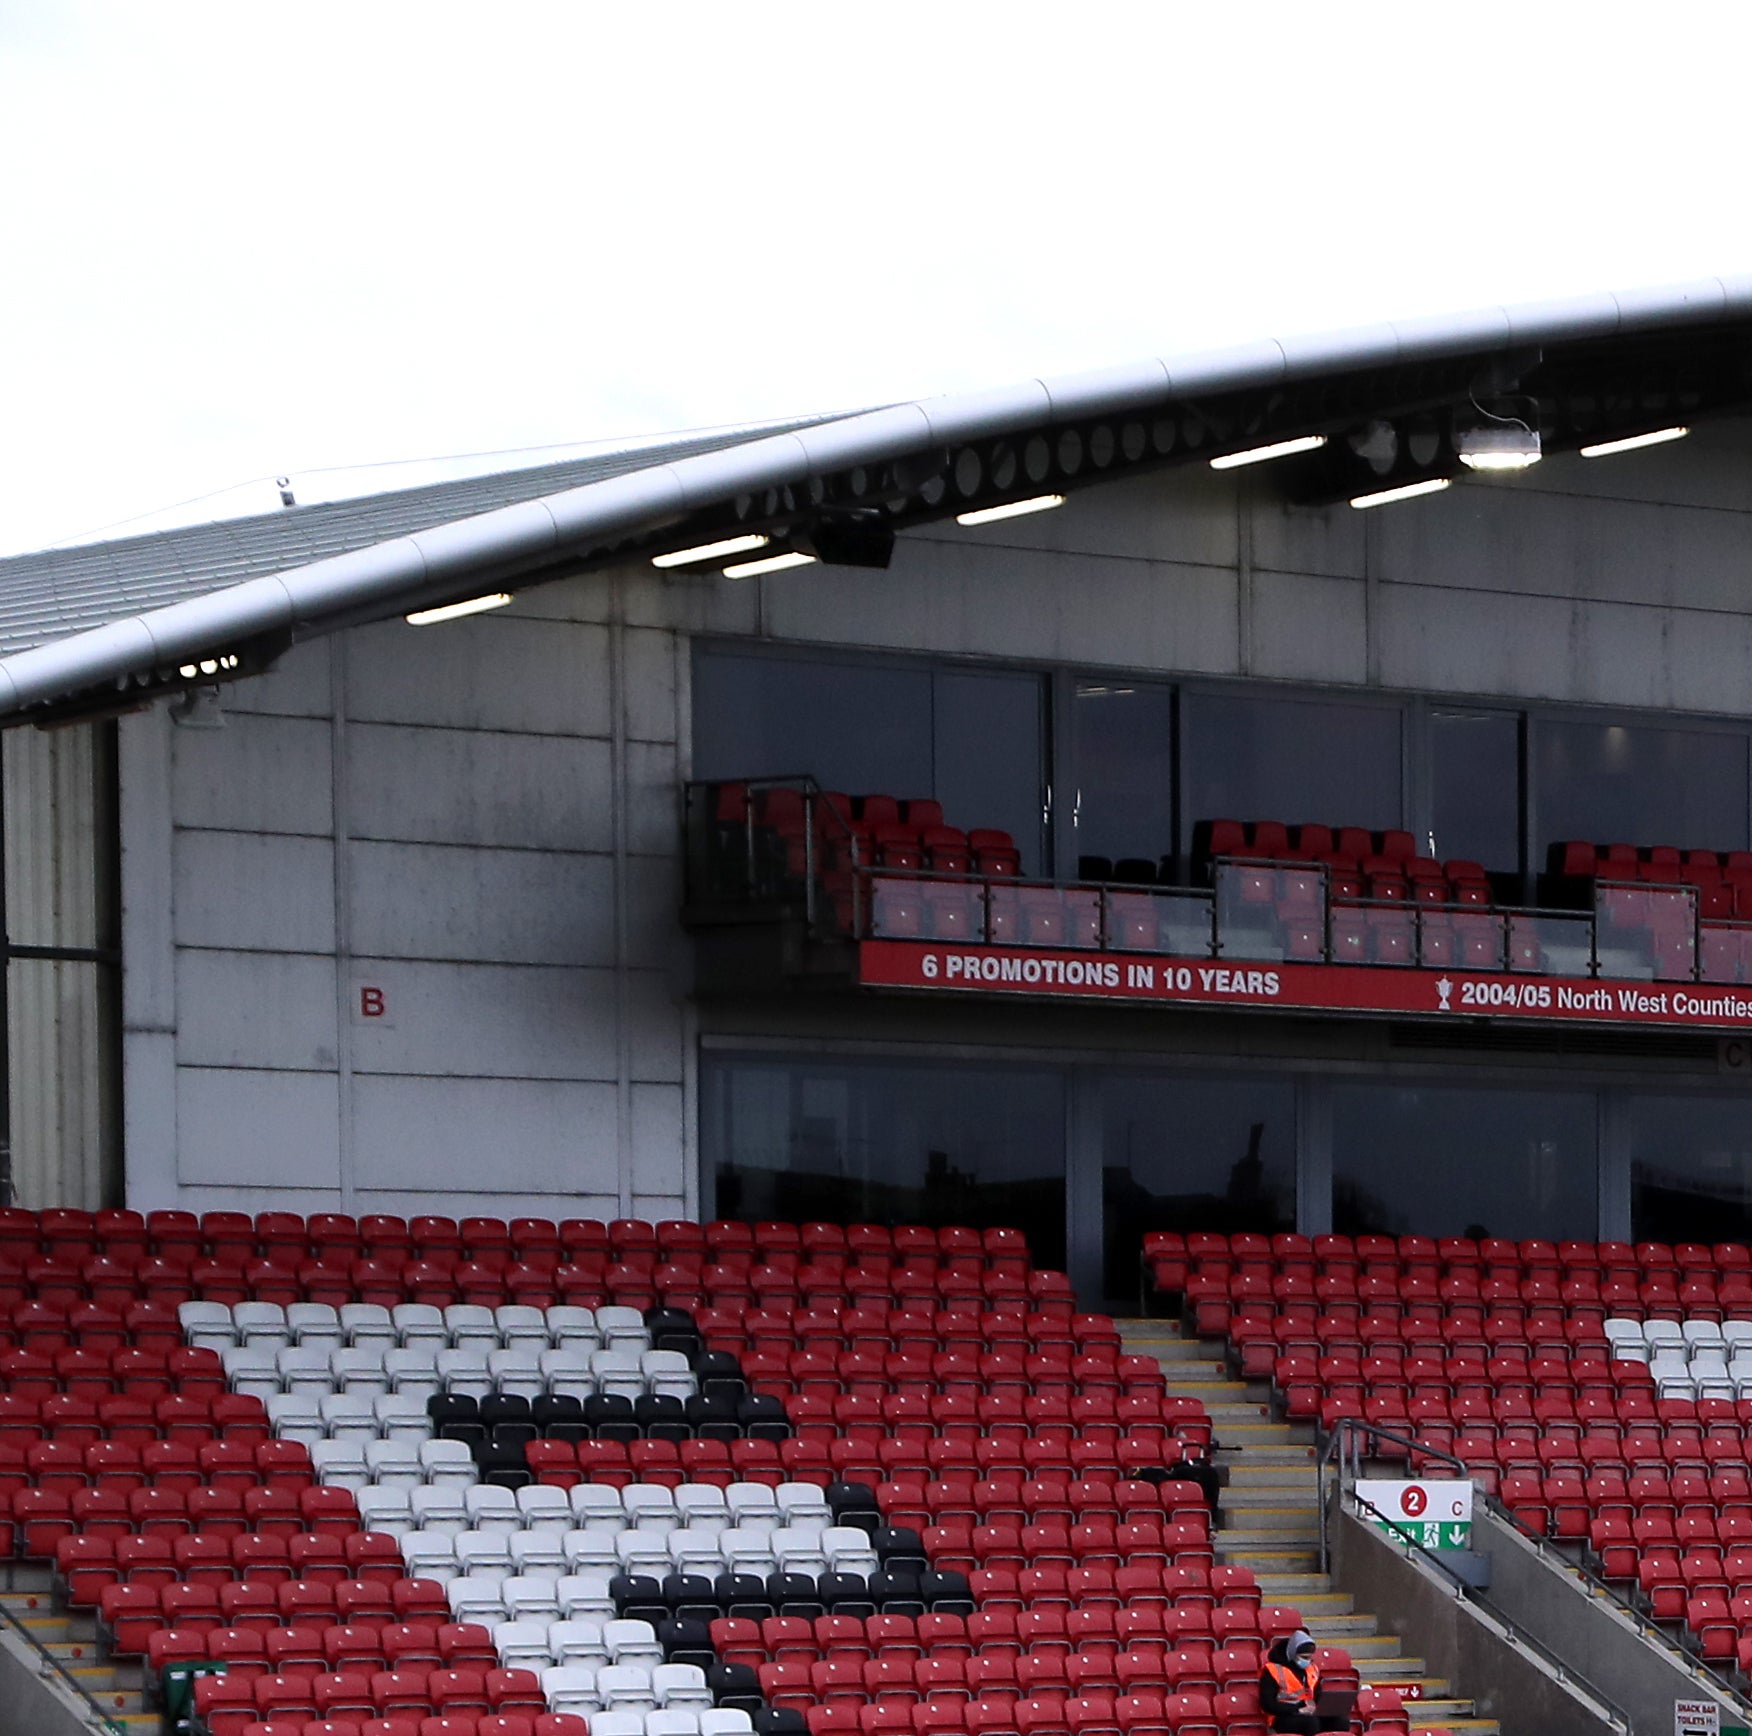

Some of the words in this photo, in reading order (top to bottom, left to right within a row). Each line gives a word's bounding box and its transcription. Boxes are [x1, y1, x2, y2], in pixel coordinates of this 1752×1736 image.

[921, 956, 938, 977] 6
[946, 957, 1120, 987] PROMOTIONS
[1127, 966, 1154, 988] IN
[1163, 967, 1192, 991] 10
[1198, 969, 1280, 995] YEARS
[361, 987, 385, 1017] B
[1461, 981, 1551, 1008] 2004/05
[1557, 987, 1613, 1011] North
[1618, 990, 1669, 1014] West
[1726, 1043, 1743, 1067] C
[1408, 1492, 1419, 1511] 2
[1452, 1501, 1464, 1517] C
[1677, 1703, 1701, 1714] SNACK
[1702, 1704, 1717, 1714] BAR
[1677, 1715, 1706, 1726] TOILETS
